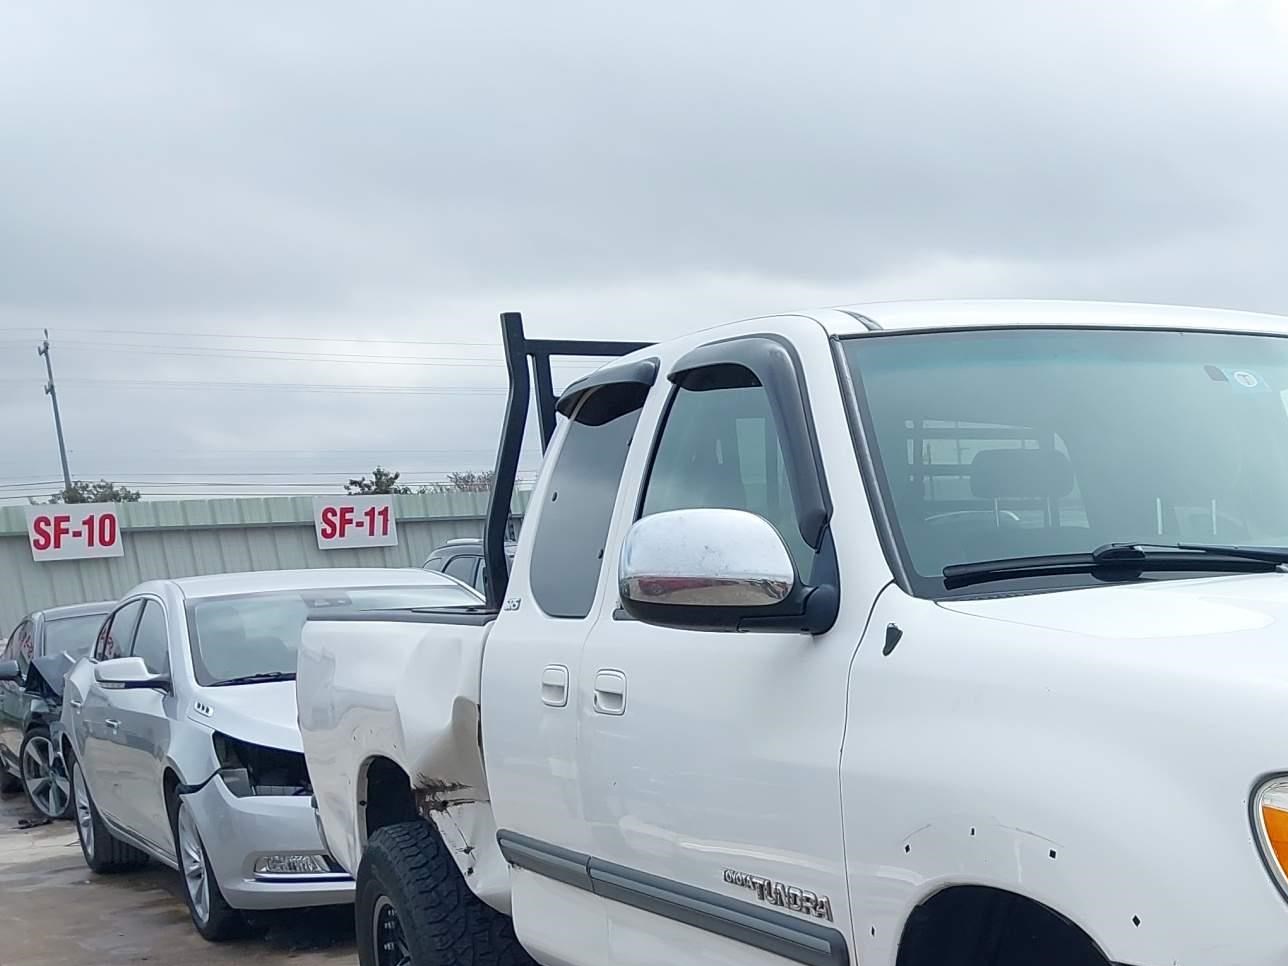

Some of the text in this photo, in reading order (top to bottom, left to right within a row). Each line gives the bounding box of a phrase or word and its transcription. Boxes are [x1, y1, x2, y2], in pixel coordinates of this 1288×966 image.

[33, 513, 116, 550] SF-10
[321, 506, 389, 539] SF-11
[753, 878, 834, 922] TUNDRA
